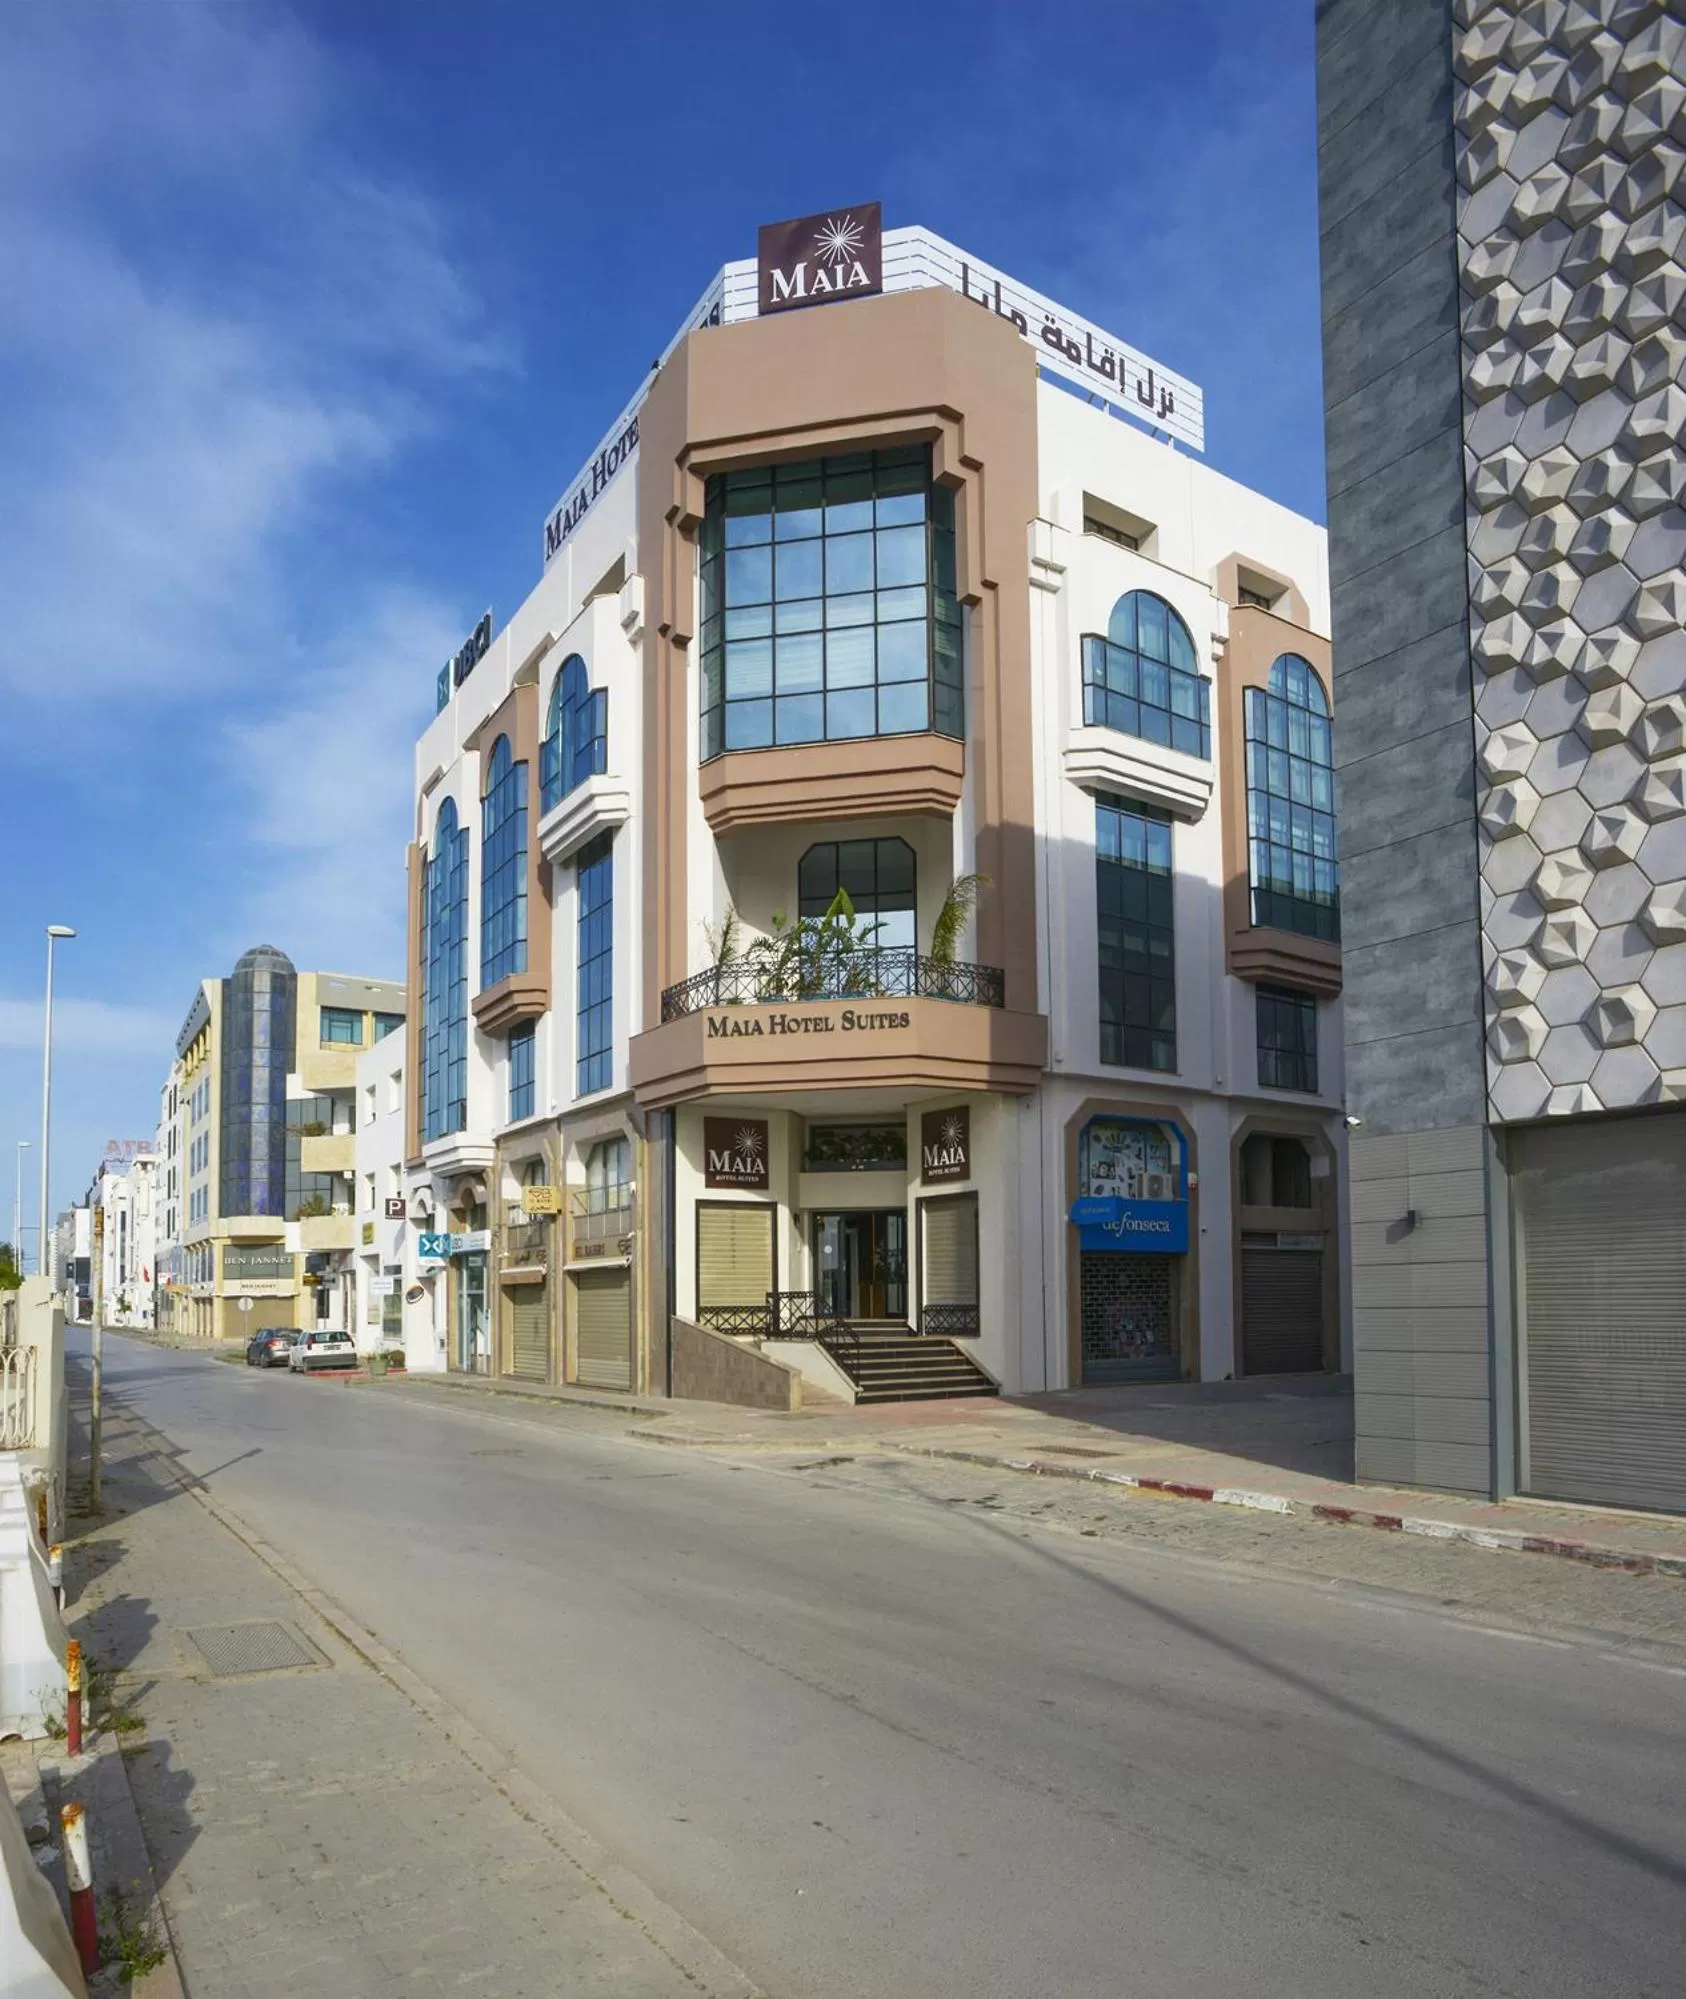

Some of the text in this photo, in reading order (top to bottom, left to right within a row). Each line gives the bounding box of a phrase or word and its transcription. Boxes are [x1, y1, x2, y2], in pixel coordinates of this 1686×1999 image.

[770, 261, 871, 303] MAIA
[1041, 315, 1126, 394] إقامة
[1137, 368, 1175, 420] نزل
[545, 416, 641, 562] MAIA HOTE
[707, 1009, 910, 1038] MAIA HOTEL SUITES
[708, 1148, 766, 1174] MAIA
[923, 1143, 966, 1169] MAIA
[389, 1200, 402, 1215] P
